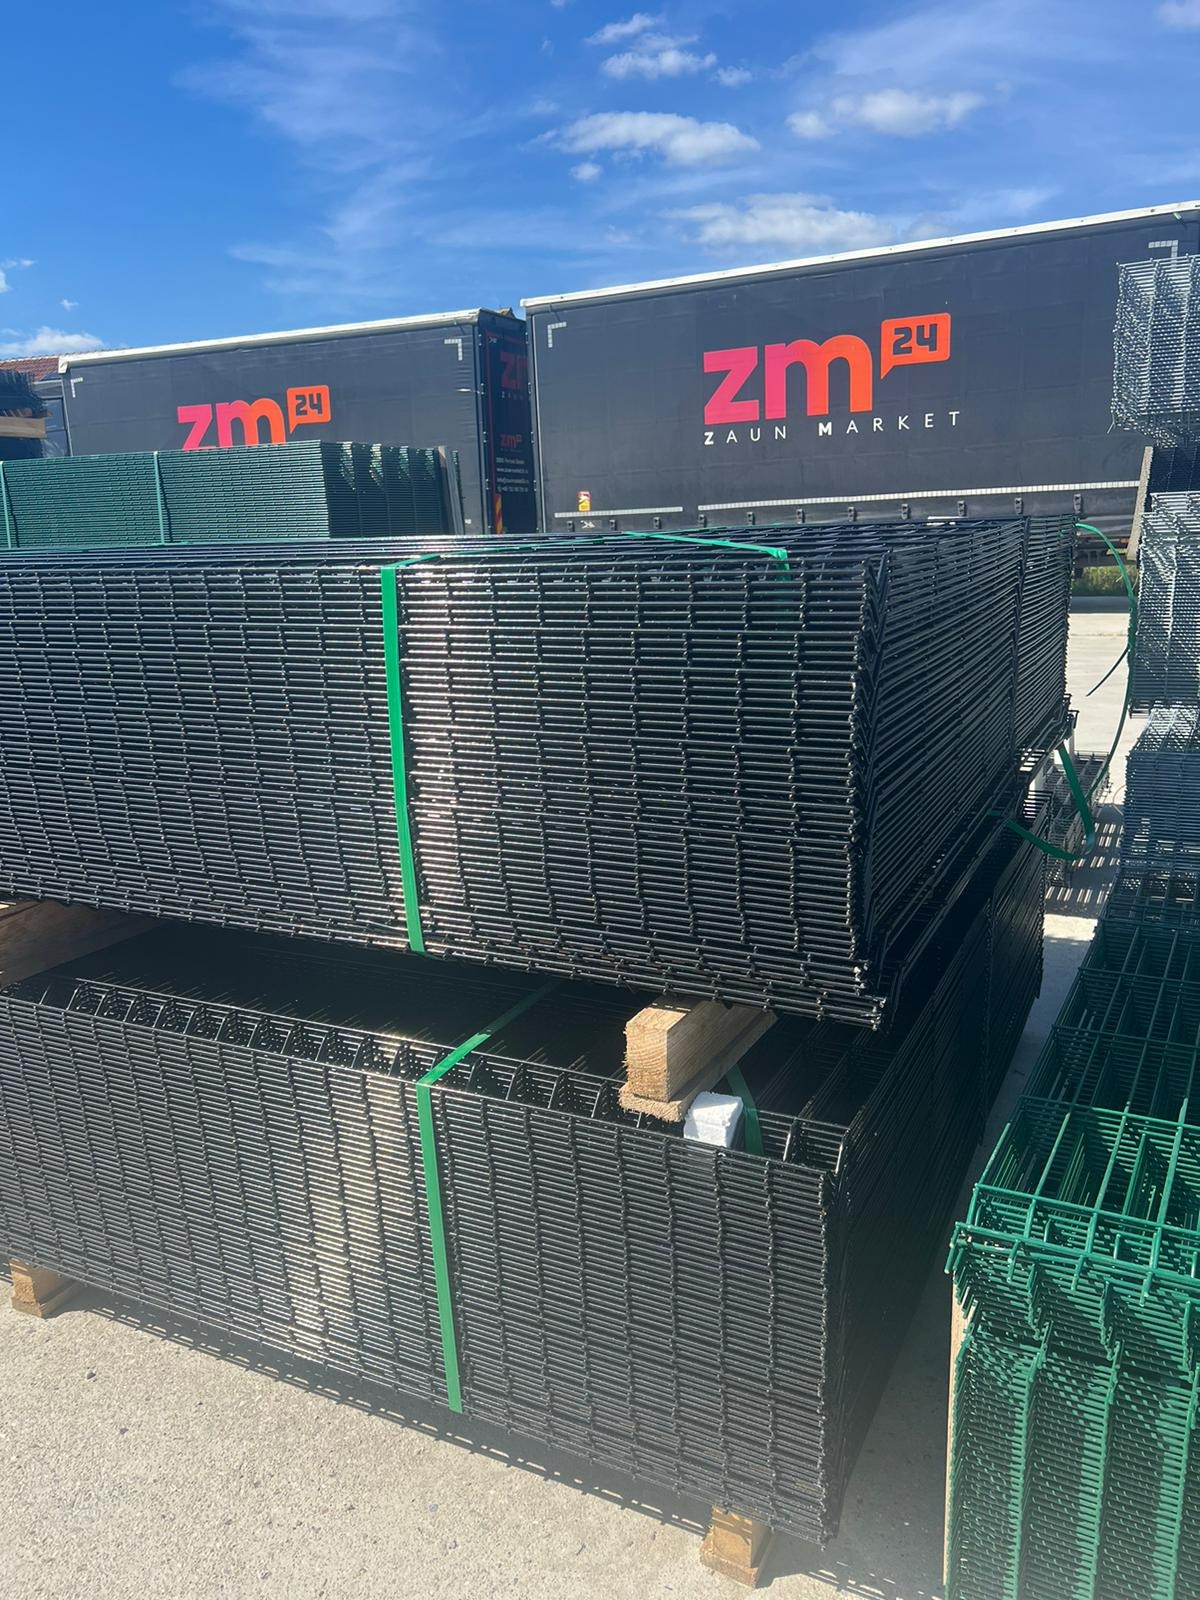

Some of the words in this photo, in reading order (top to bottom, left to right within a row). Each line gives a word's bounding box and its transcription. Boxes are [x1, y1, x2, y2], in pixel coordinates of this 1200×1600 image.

[704, 334, 872, 425] zm
[892, 323, 938, 356] 24
[178, 398, 286, 450] zm
[295, 393, 323, 416] 24
[704, 425, 787, 446] ZAUN
[818, 411, 960, 437] MARKET
